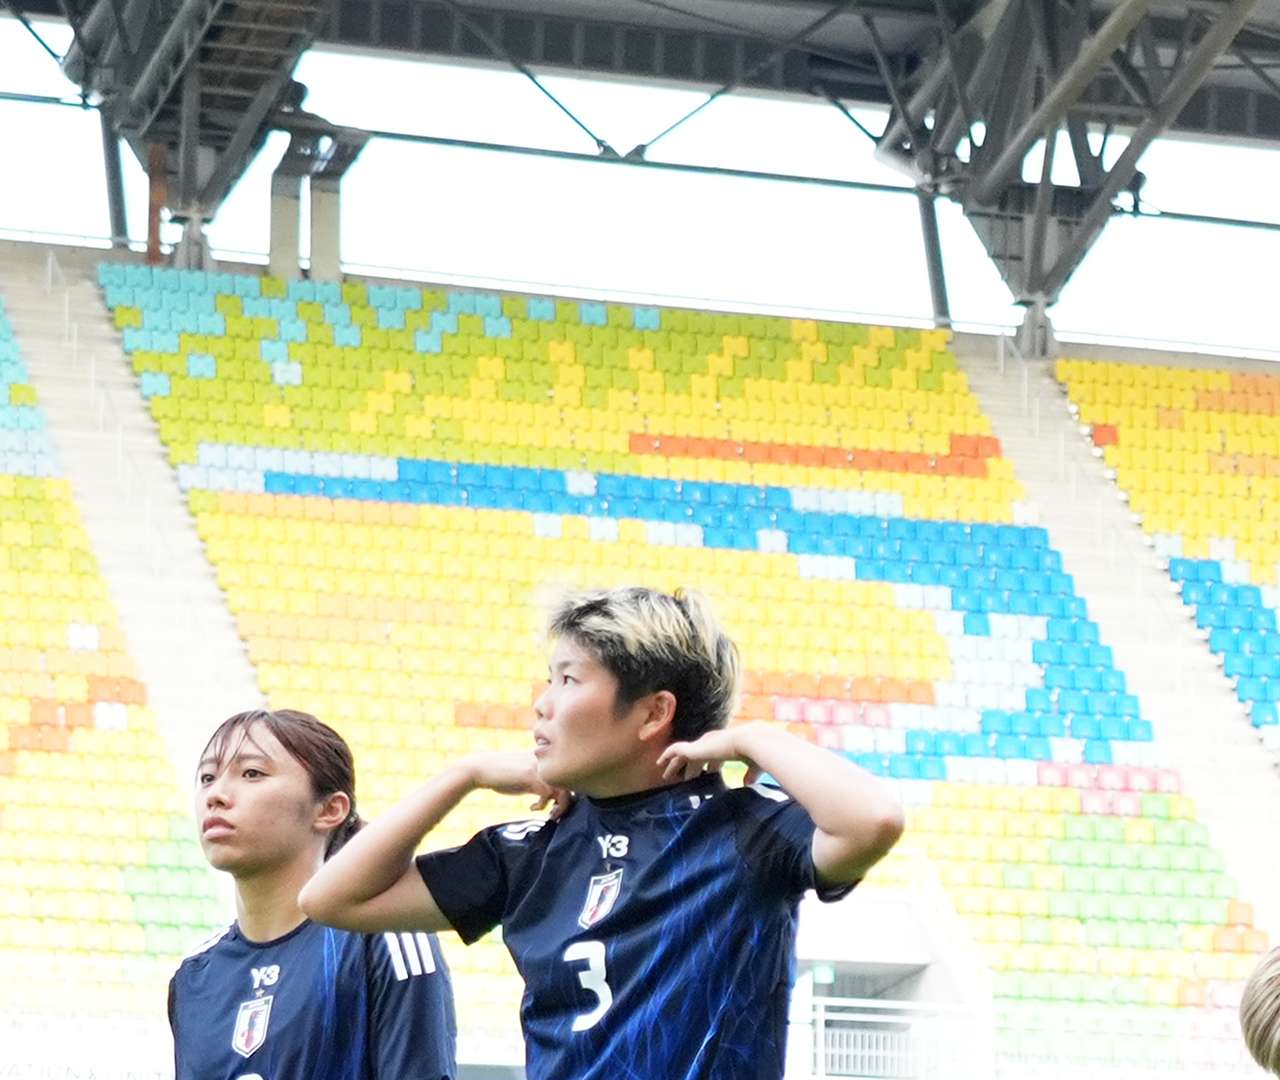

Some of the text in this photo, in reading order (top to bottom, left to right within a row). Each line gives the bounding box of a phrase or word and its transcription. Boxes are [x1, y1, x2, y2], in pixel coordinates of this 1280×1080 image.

[597, 834, 629, 859] Y-3
[251, 964, 280, 988] Y-3
[563, 941, 613, 1032] 3
